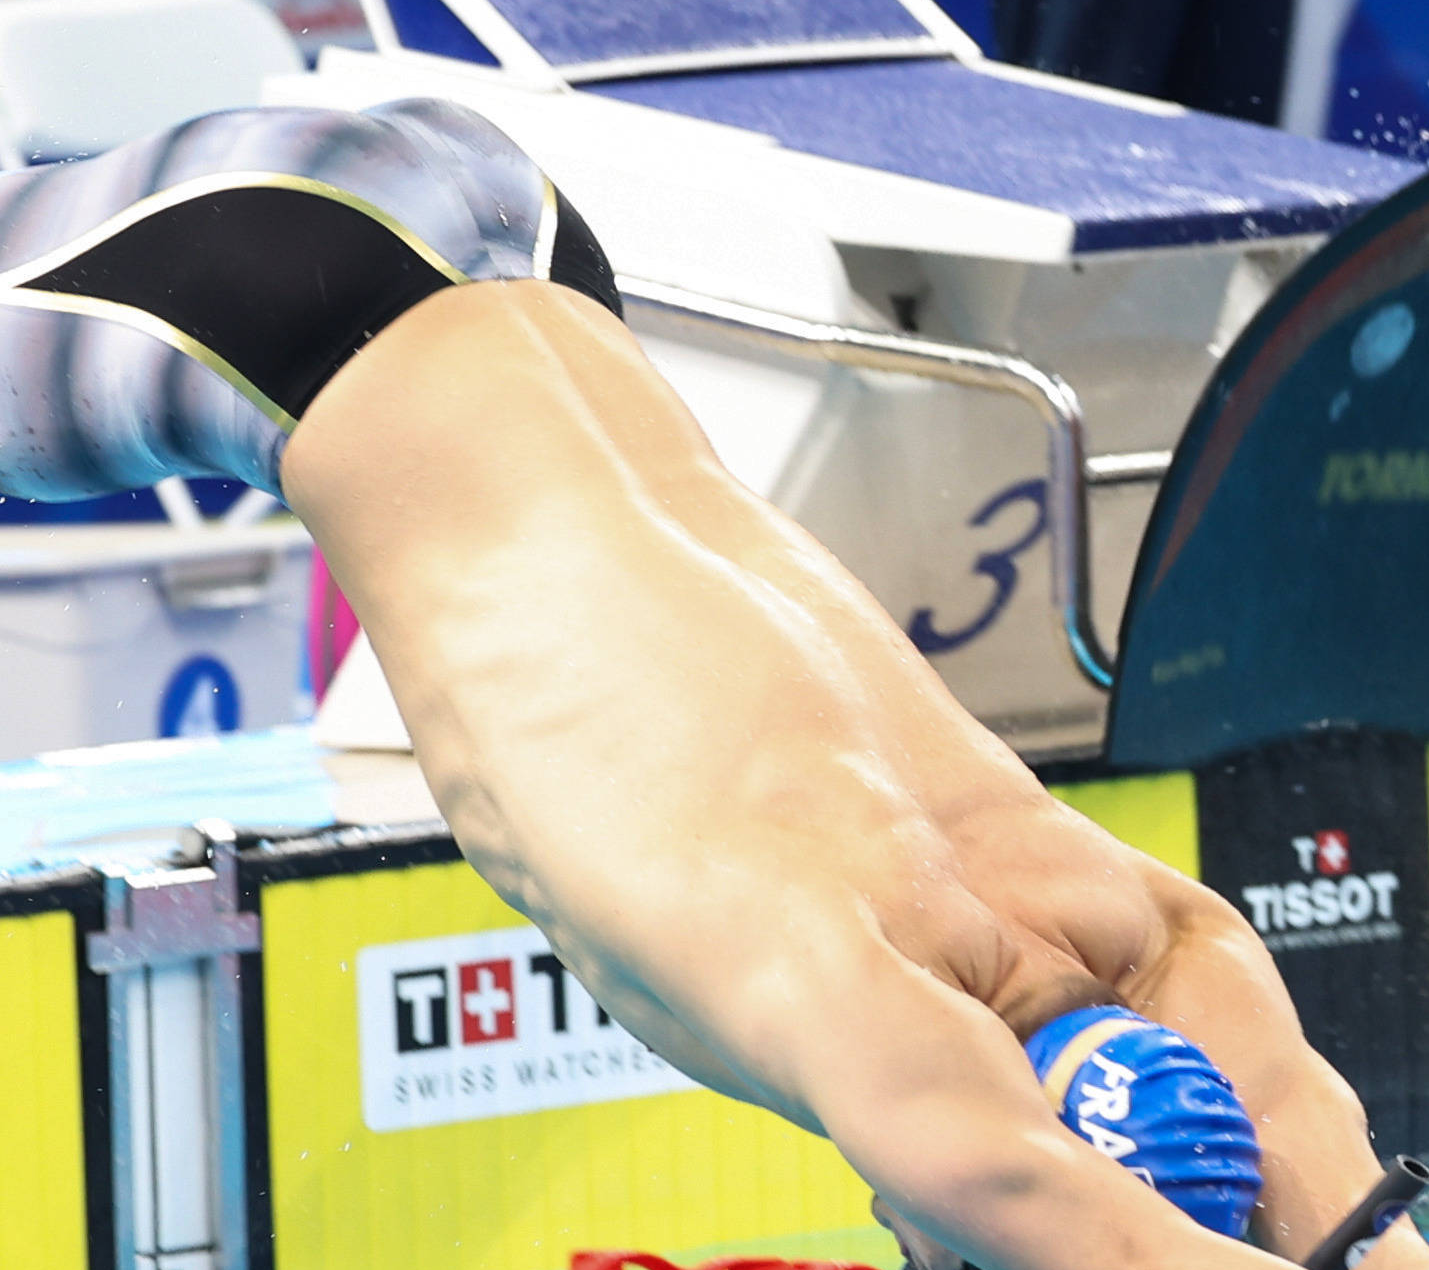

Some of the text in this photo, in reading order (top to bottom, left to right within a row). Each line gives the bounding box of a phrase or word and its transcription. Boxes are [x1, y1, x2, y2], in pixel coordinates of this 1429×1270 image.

[908, 477, 1047, 656] 3
[1242, 871, 1399, 931] TISSOT
[394, 1062, 498, 1105] SWISS
